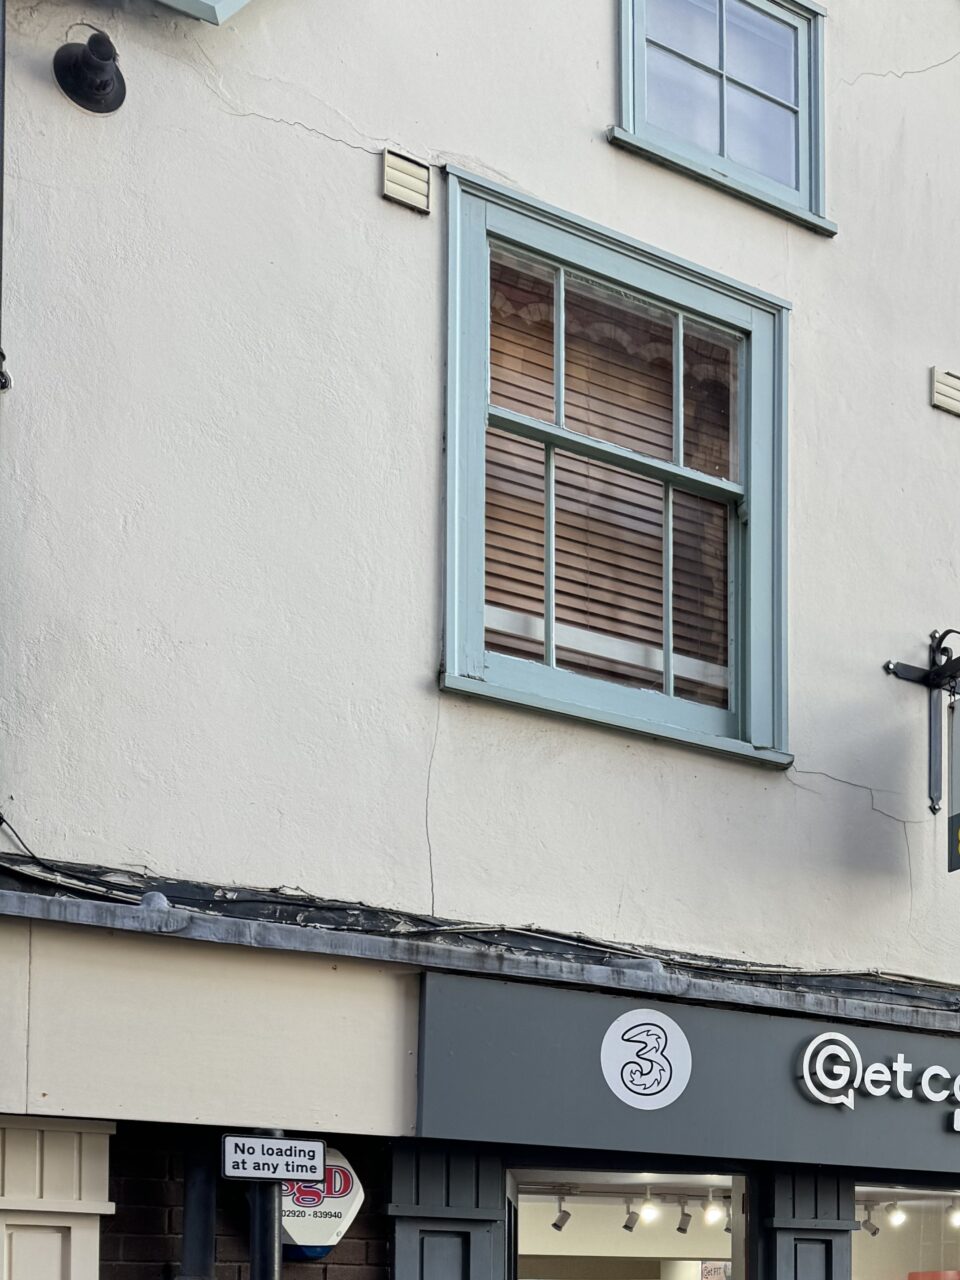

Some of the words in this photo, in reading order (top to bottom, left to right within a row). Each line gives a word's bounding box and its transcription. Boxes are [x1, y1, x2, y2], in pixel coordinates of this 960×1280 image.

[816, 1045, 912, 1098] Get
[233, 1142, 256, 1156] No
[261, 1144, 316, 1160] loading
[232, 1159, 247, 1171] at
[252, 1161, 279, 1174] any
[285, 1161, 318, 1174] time
[281, 1210, 306, 1219] 02920
[312, 1210, 343, 1219] 839940
